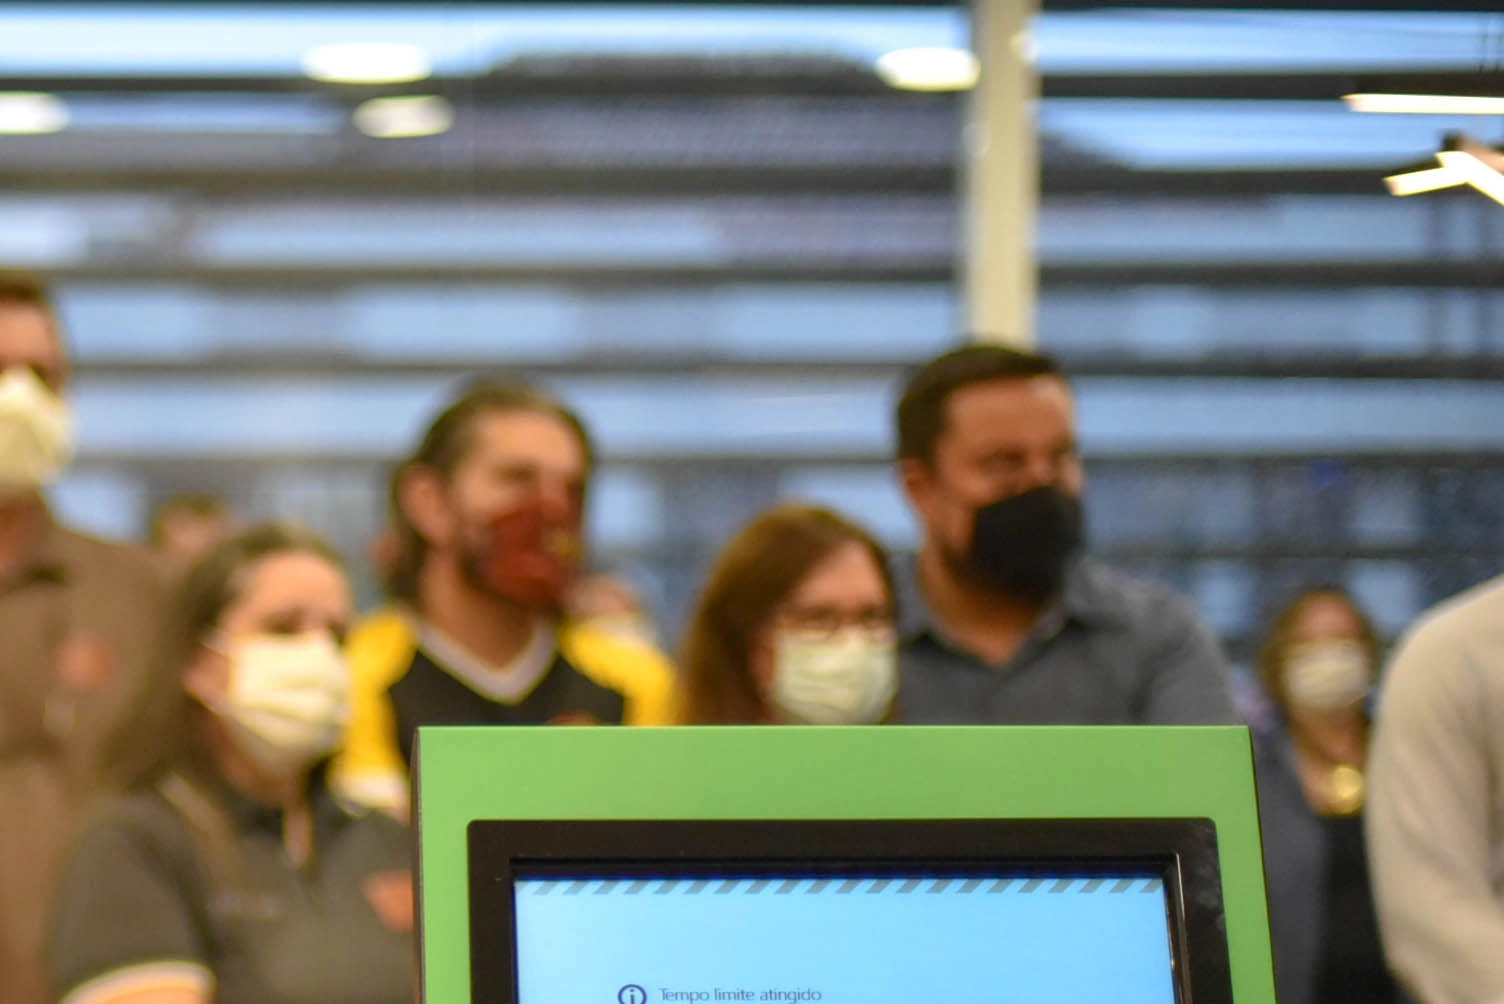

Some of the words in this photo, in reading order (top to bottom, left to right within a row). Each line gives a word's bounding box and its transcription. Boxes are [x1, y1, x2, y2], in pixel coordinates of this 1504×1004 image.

[658, 987, 710, 1004] Tempo
[714, 986, 755, 1001] limite
[759, 986, 823, 1004] atingido
